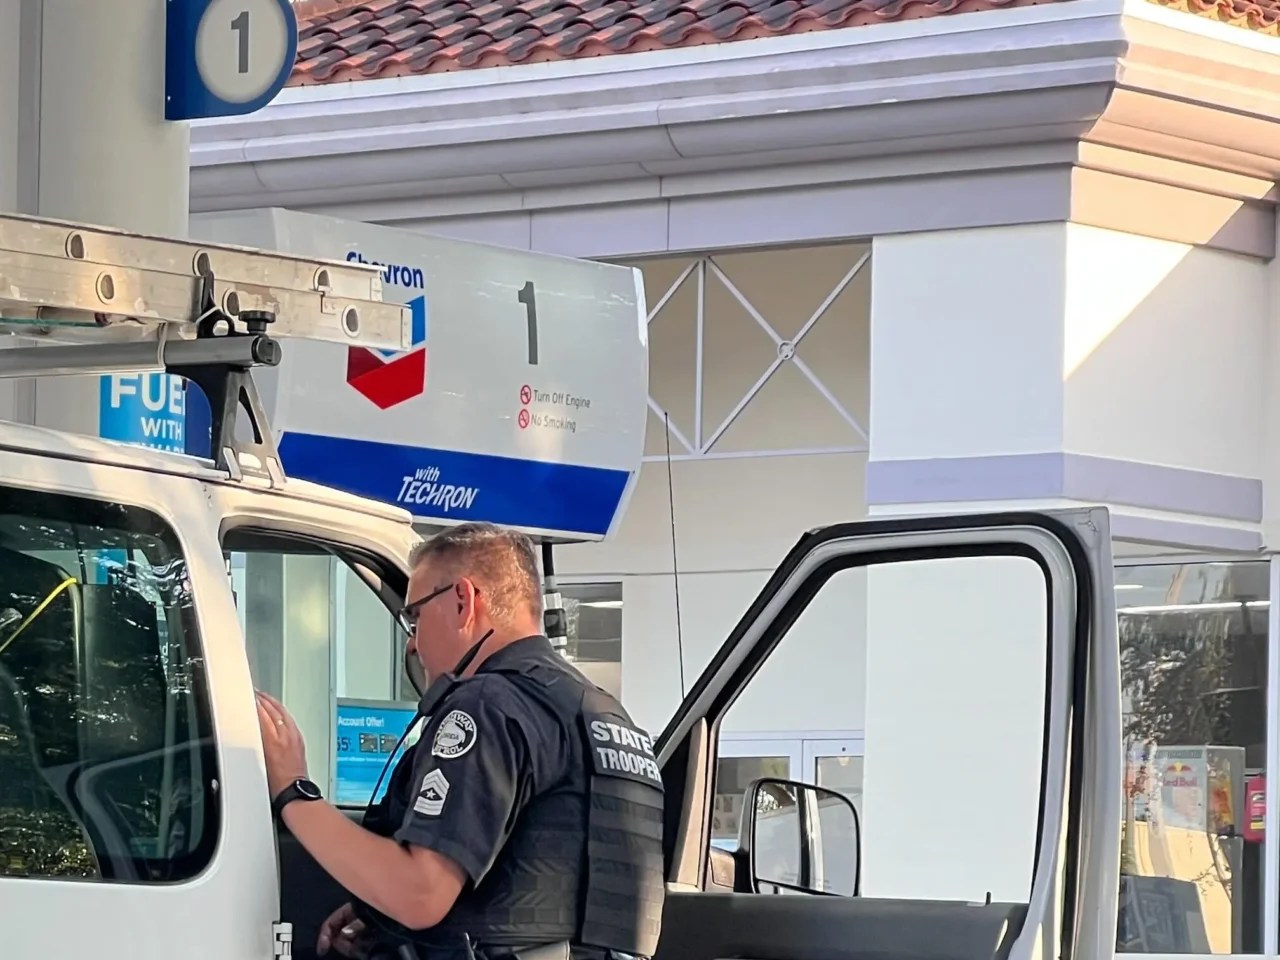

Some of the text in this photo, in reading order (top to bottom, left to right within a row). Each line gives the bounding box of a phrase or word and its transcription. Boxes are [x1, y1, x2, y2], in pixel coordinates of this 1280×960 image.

[230, 11, 250, 74] 1
[518, 281, 538, 365] 1
[111, 374, 186, 416] FUE
[533, 389, 591, 409] Turn Off Engine
[141, 417, 182, 441] WITH
[531, 414, 576, 433] No Smoking
[414, 466, 440, 482] with
[397, 476, 479, 512] TECHRON
[338, 716, 365, 727] Account
[591, 720, 655, 757] STATE
[597, 747, 662, 783] TROOPER
